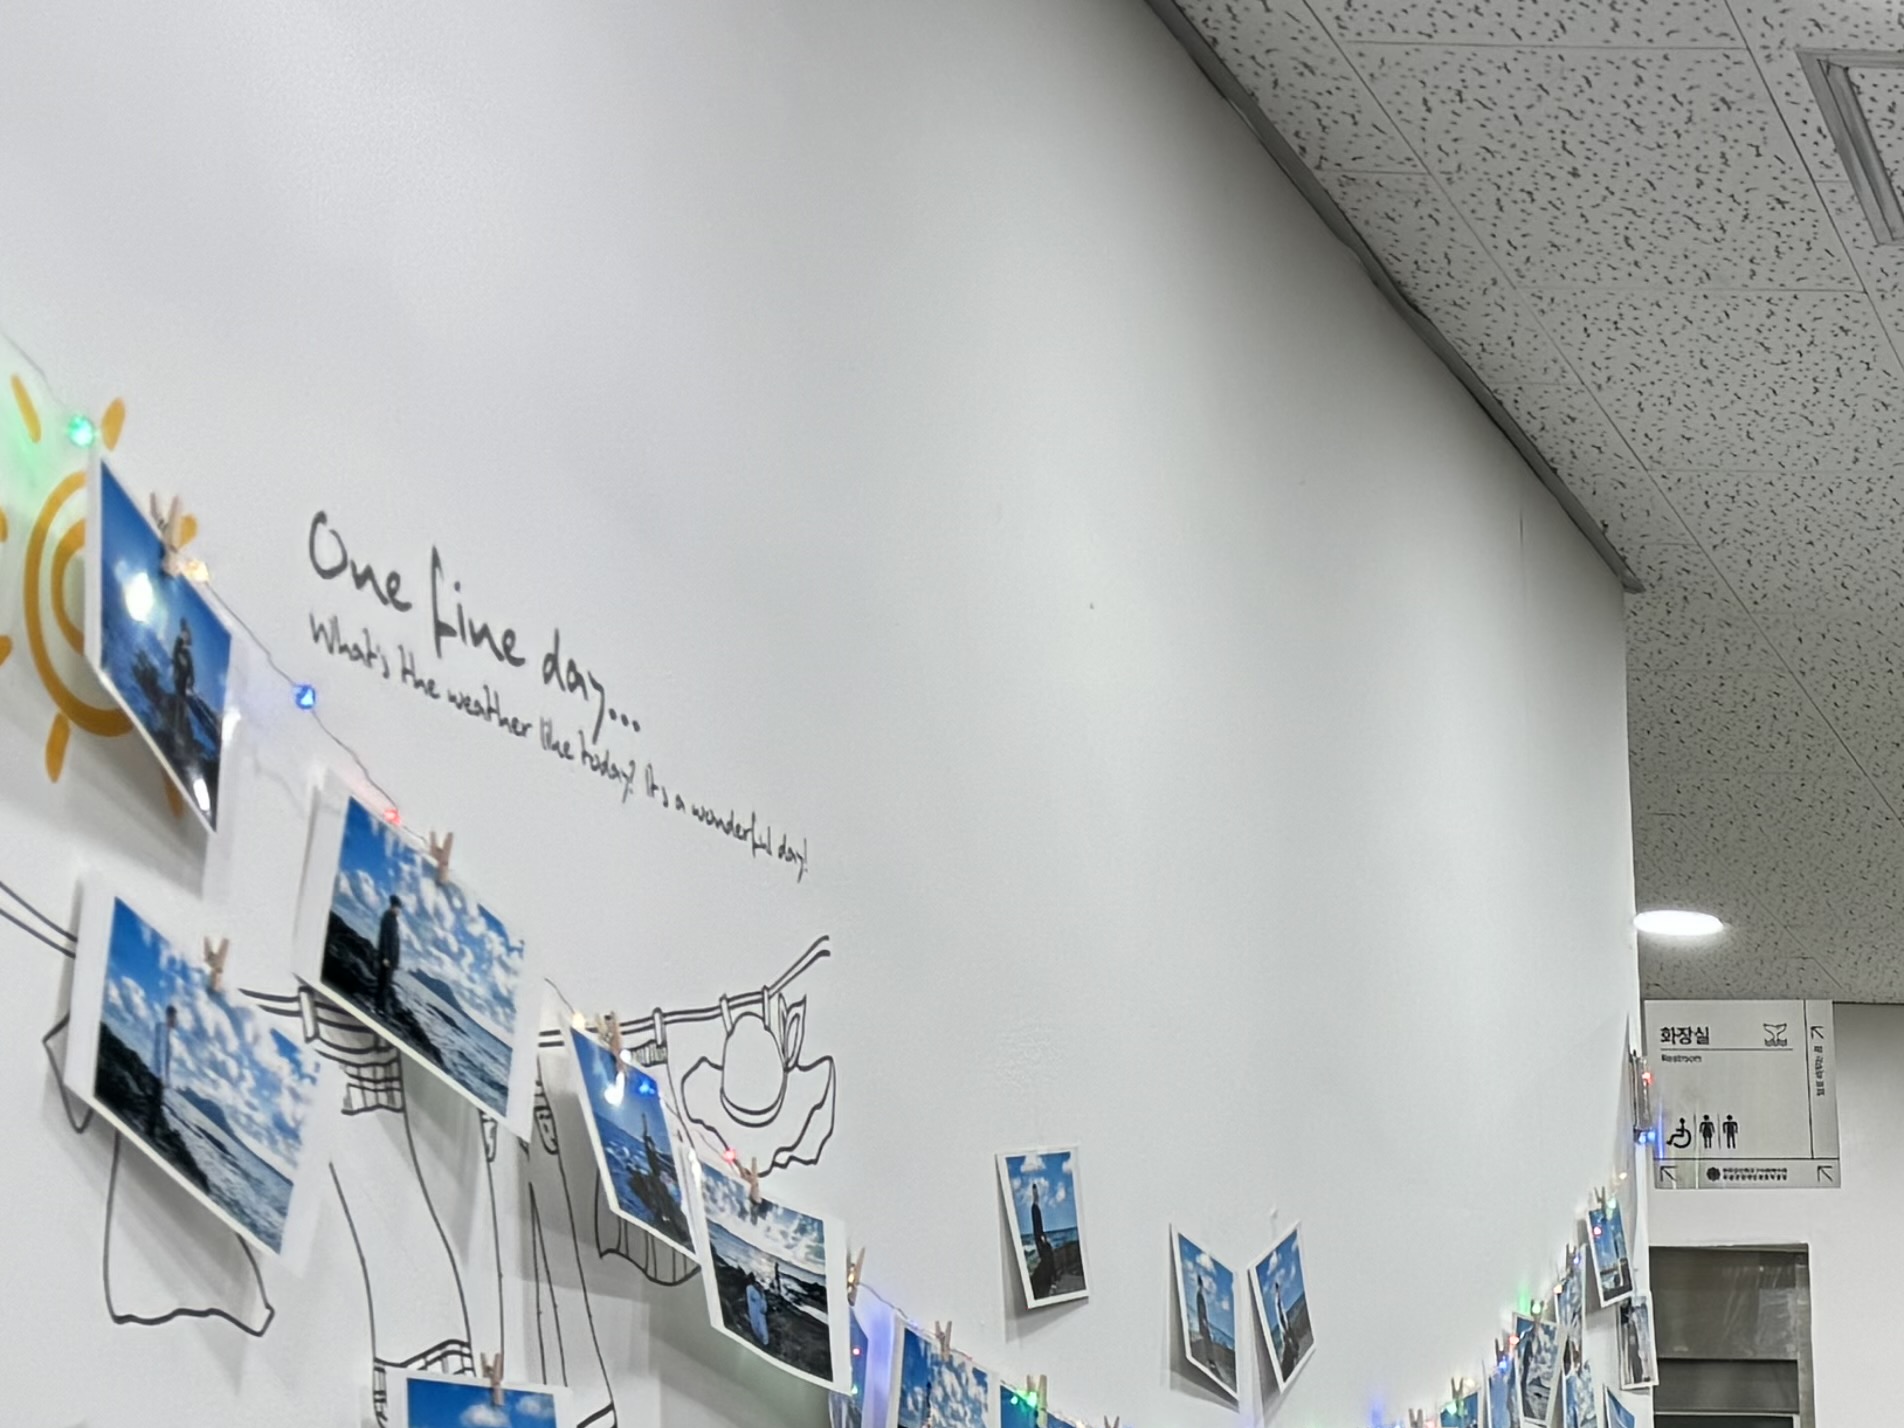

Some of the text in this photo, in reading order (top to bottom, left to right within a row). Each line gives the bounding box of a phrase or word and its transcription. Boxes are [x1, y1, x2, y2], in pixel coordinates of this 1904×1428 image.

[310, 511, 412, 612] One
[431, 544, 525, 666] fine
[309, 611, 390, 679] What's
[400, 645, 440, 700] the
[448, 685, 532, 738] weather
[675, 794, 687, 812] a
[692, 811, 773, 858] wonderful
[1660, 1026, 1710, 1045] 화장실
